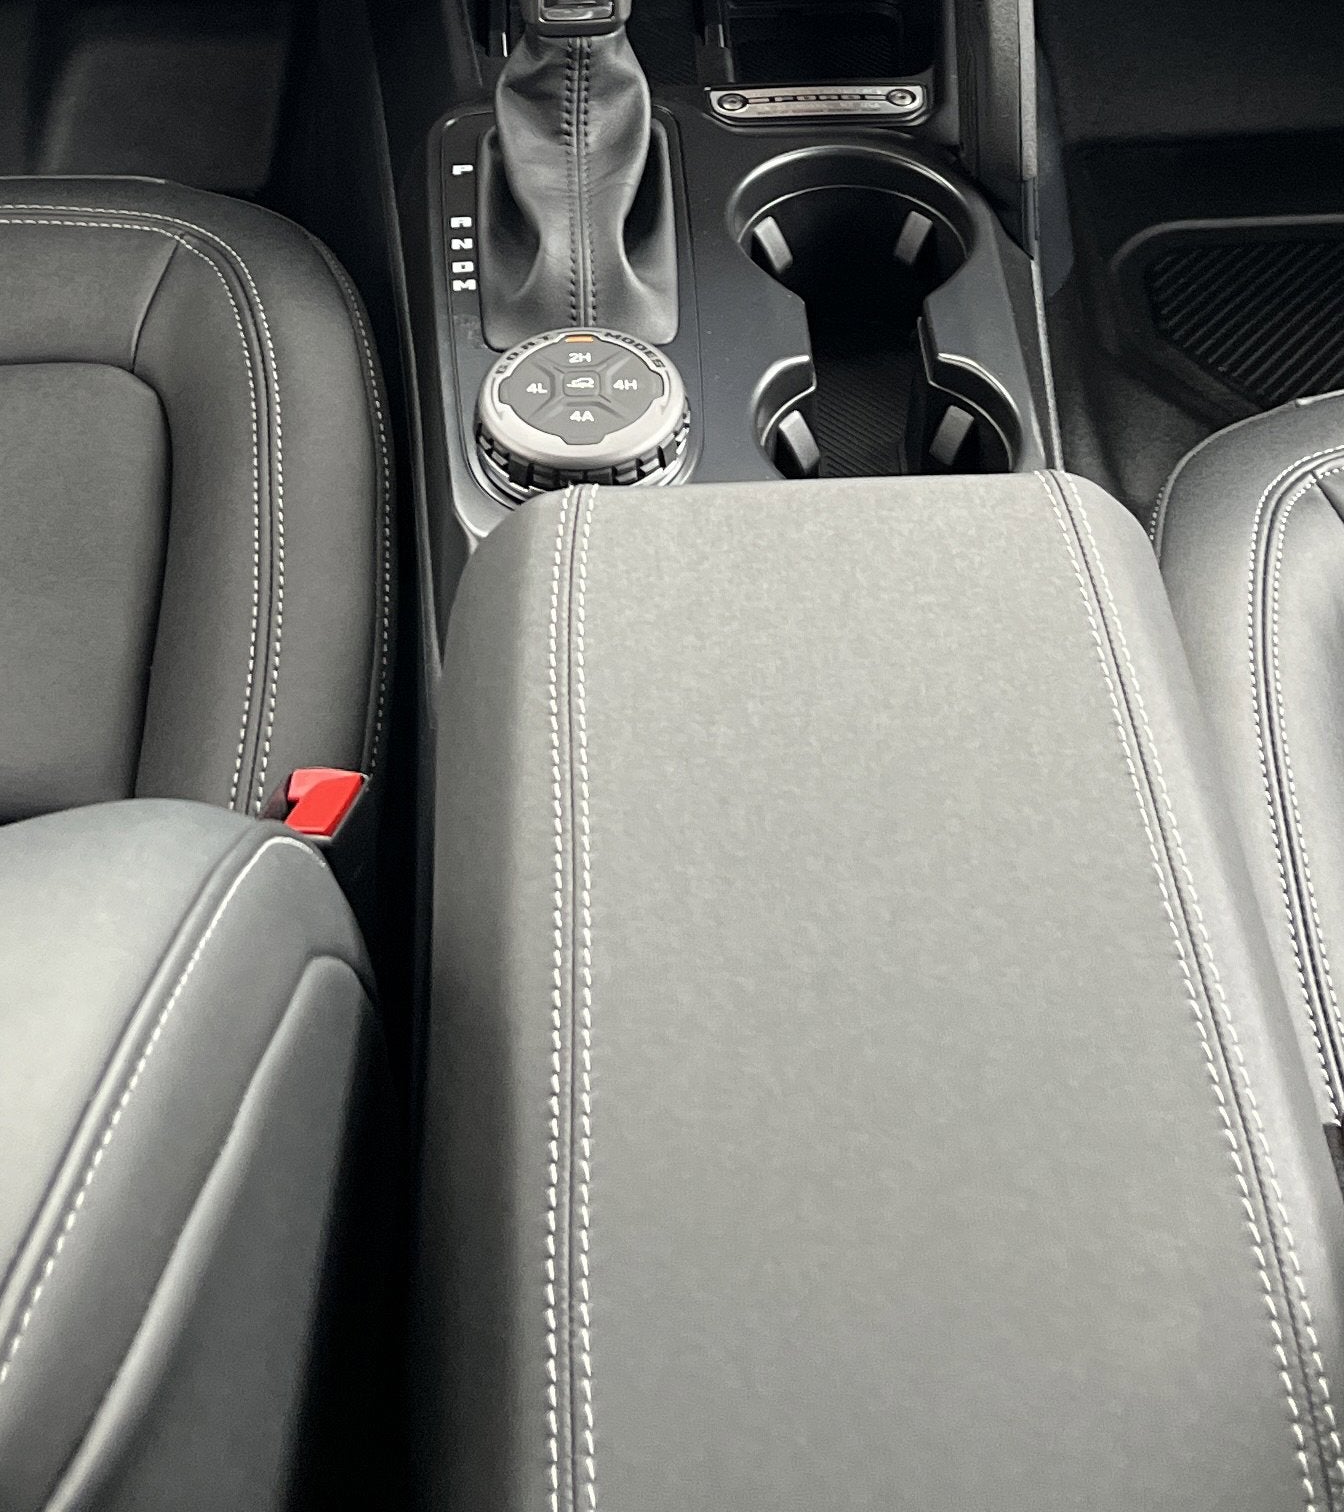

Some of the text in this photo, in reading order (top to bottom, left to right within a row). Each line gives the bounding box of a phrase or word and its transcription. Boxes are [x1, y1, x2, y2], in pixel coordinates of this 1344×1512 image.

[451, 164, 474, 176] P
[451, 238, 473, 250] N
[452, 260, 474, 273] D
[452, 278, 476, 291] M
[604, 332, 666, 368] MODES
[568, 352, 591, 363] 2H
[526, 383, 548, 394] 4L
[613, 379, 638, 390] 4H
[569, 410, 595, 422] 4A
